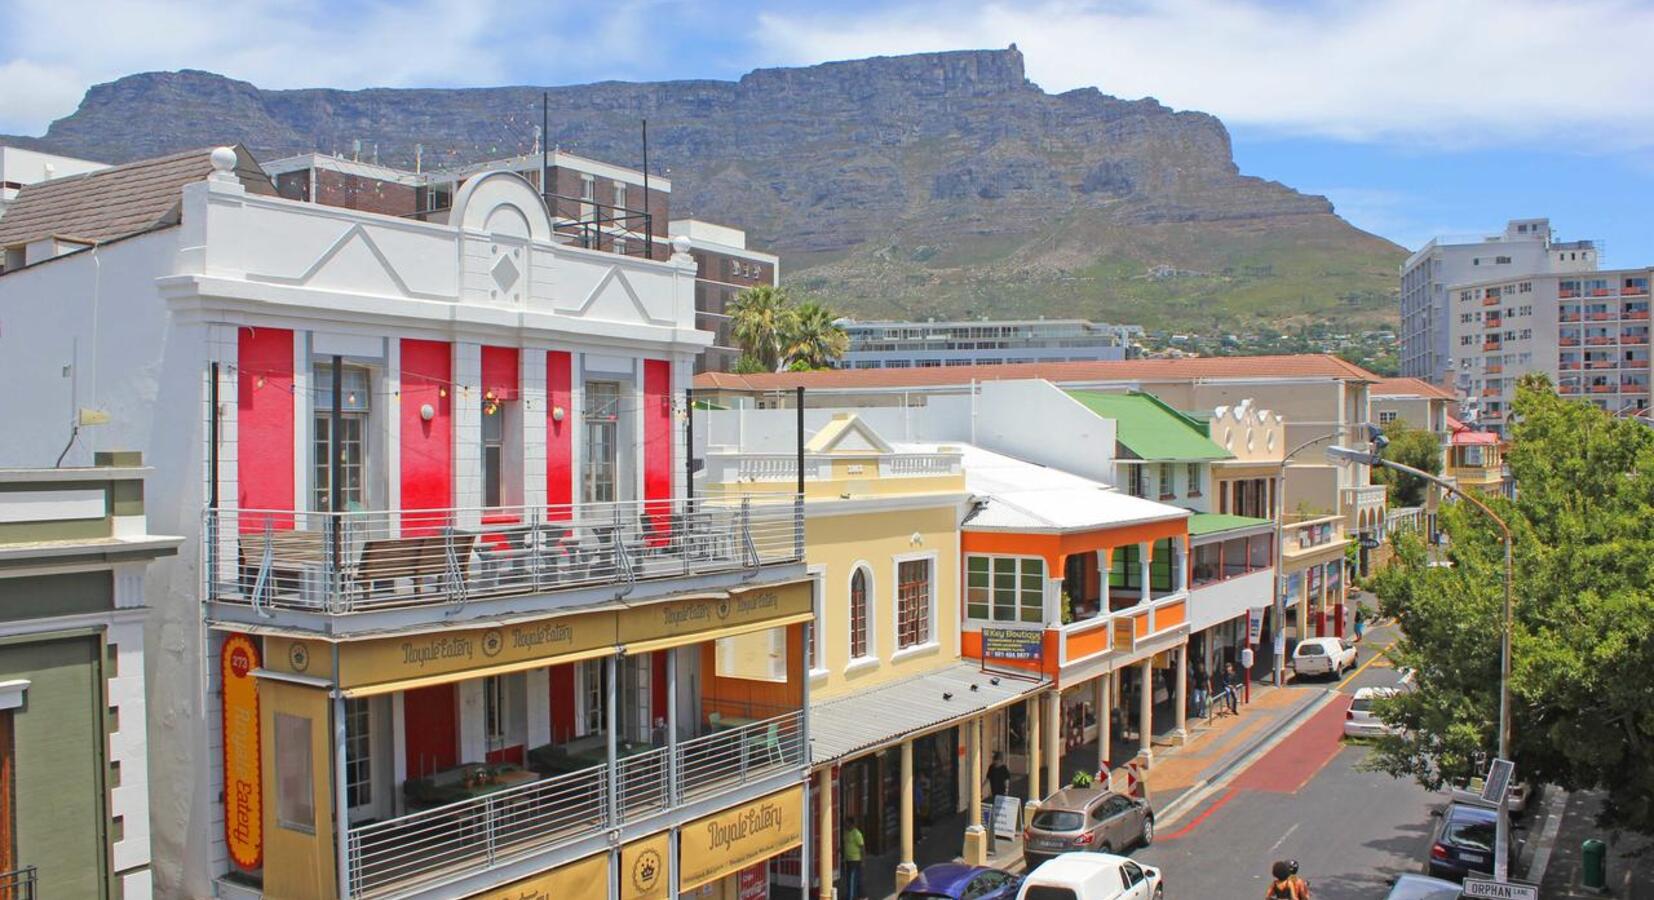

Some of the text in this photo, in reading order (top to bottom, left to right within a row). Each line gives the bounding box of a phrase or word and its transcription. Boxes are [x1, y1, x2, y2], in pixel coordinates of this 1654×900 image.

[512, 623, 573, 651] Royale Eatery
[233, 655, 248, 669] 273
[402, 637, 473, 667] Royale Eatery
[233, 779, 252, 845] Eatery
[707, 803, 782, 851] Royale Eatery
[1472, 883, 1511, 898] ORPHAN
